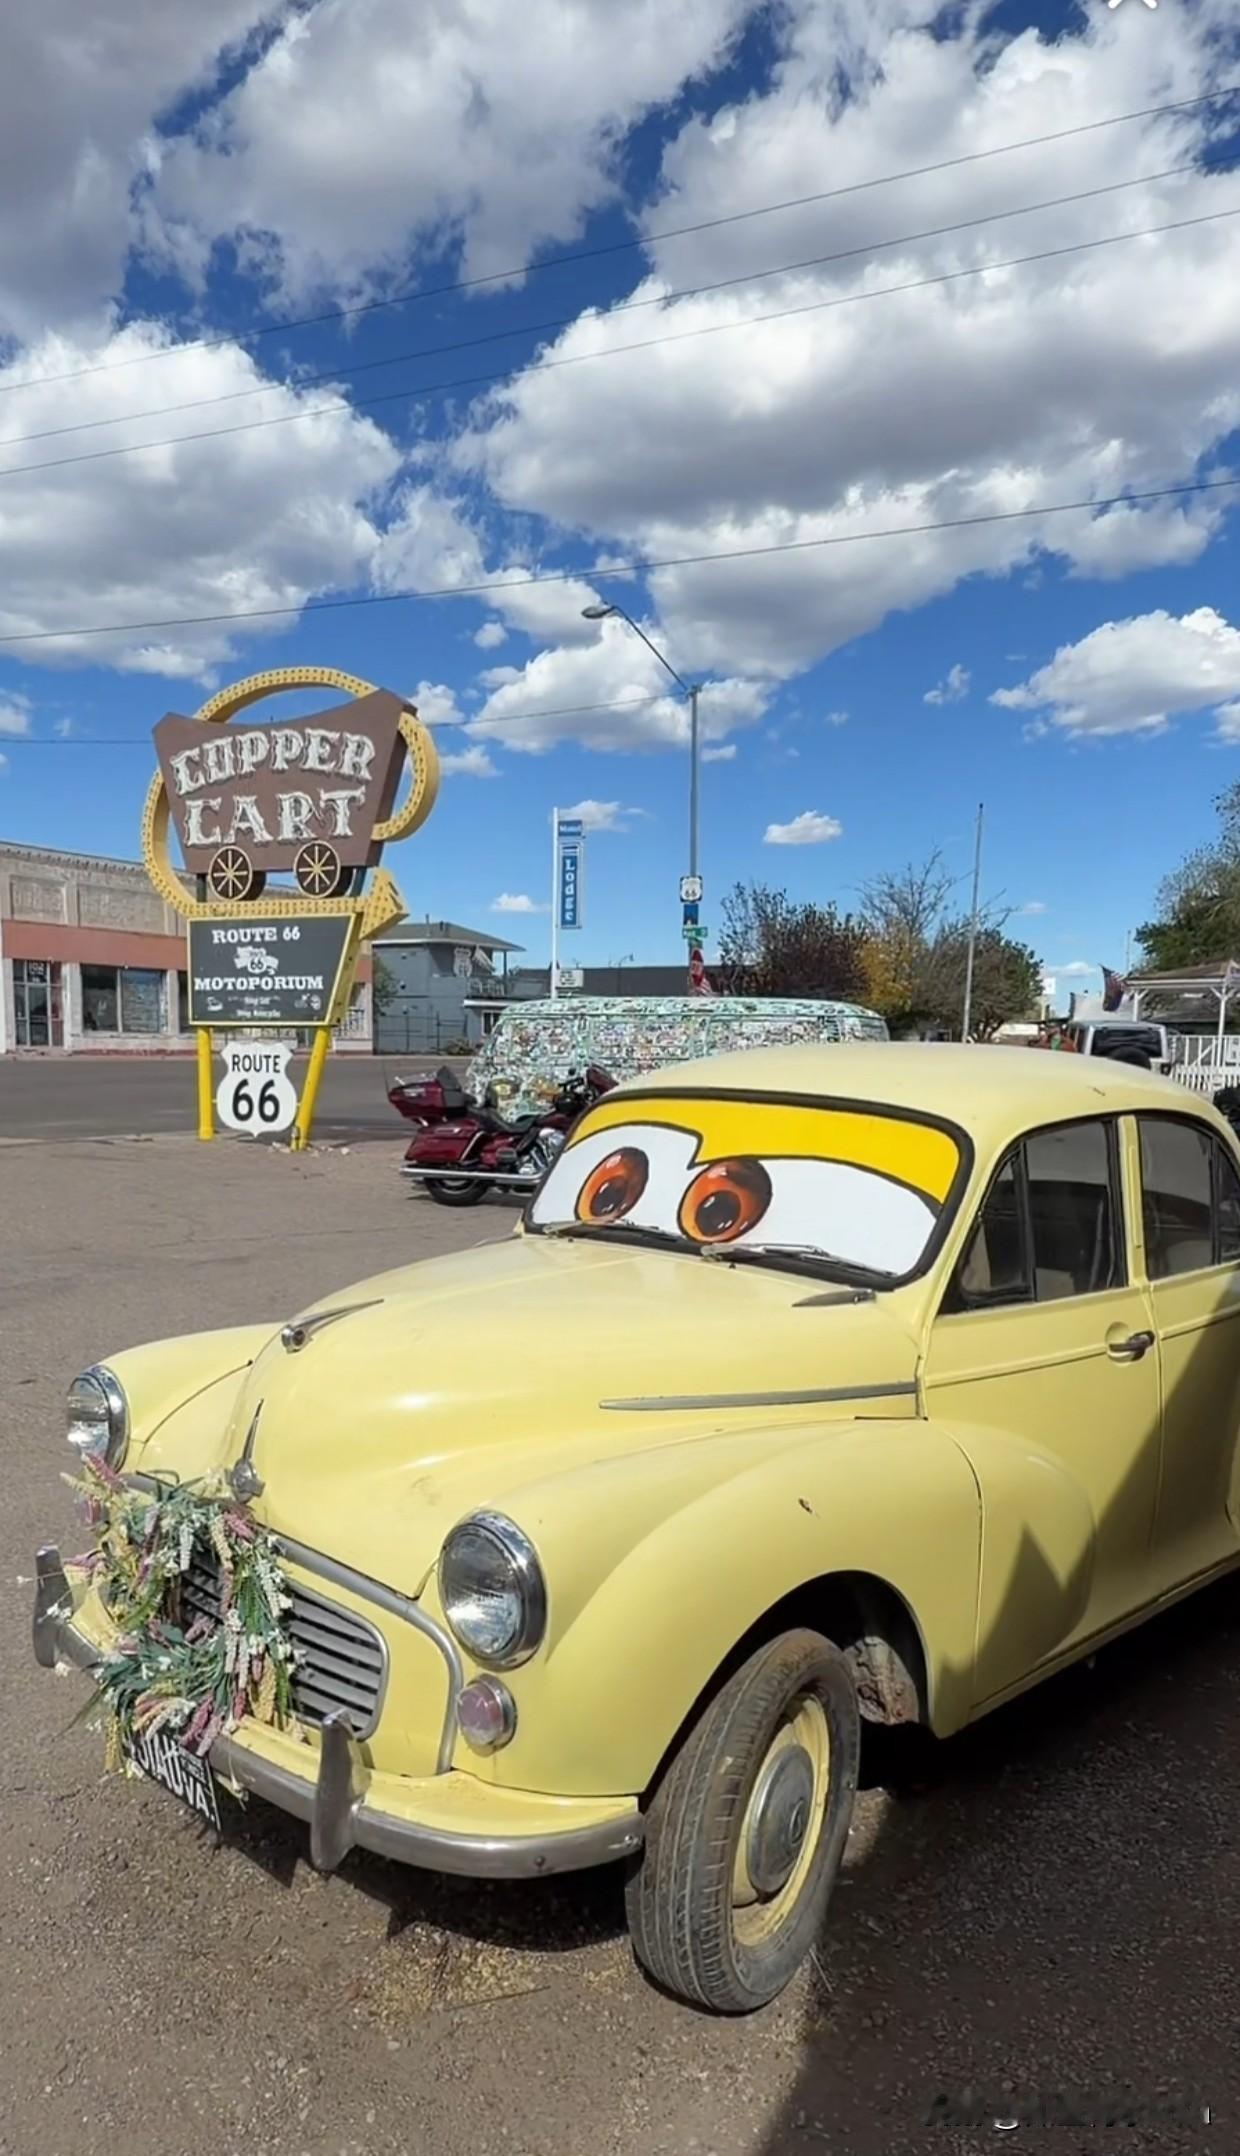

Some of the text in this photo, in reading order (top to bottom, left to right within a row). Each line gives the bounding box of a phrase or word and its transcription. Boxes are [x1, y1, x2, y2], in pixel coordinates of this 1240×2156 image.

[184, 785, 366, 847] CART
[212, 925, 301, 944] ROUTE 66
[250, 957, 264, 970] 66
[193, 975, 324, 991] MOTOPORIUM
[232, 1054, 281, 1073] ROUTE
[232, 1078, 280, 1123] 66
